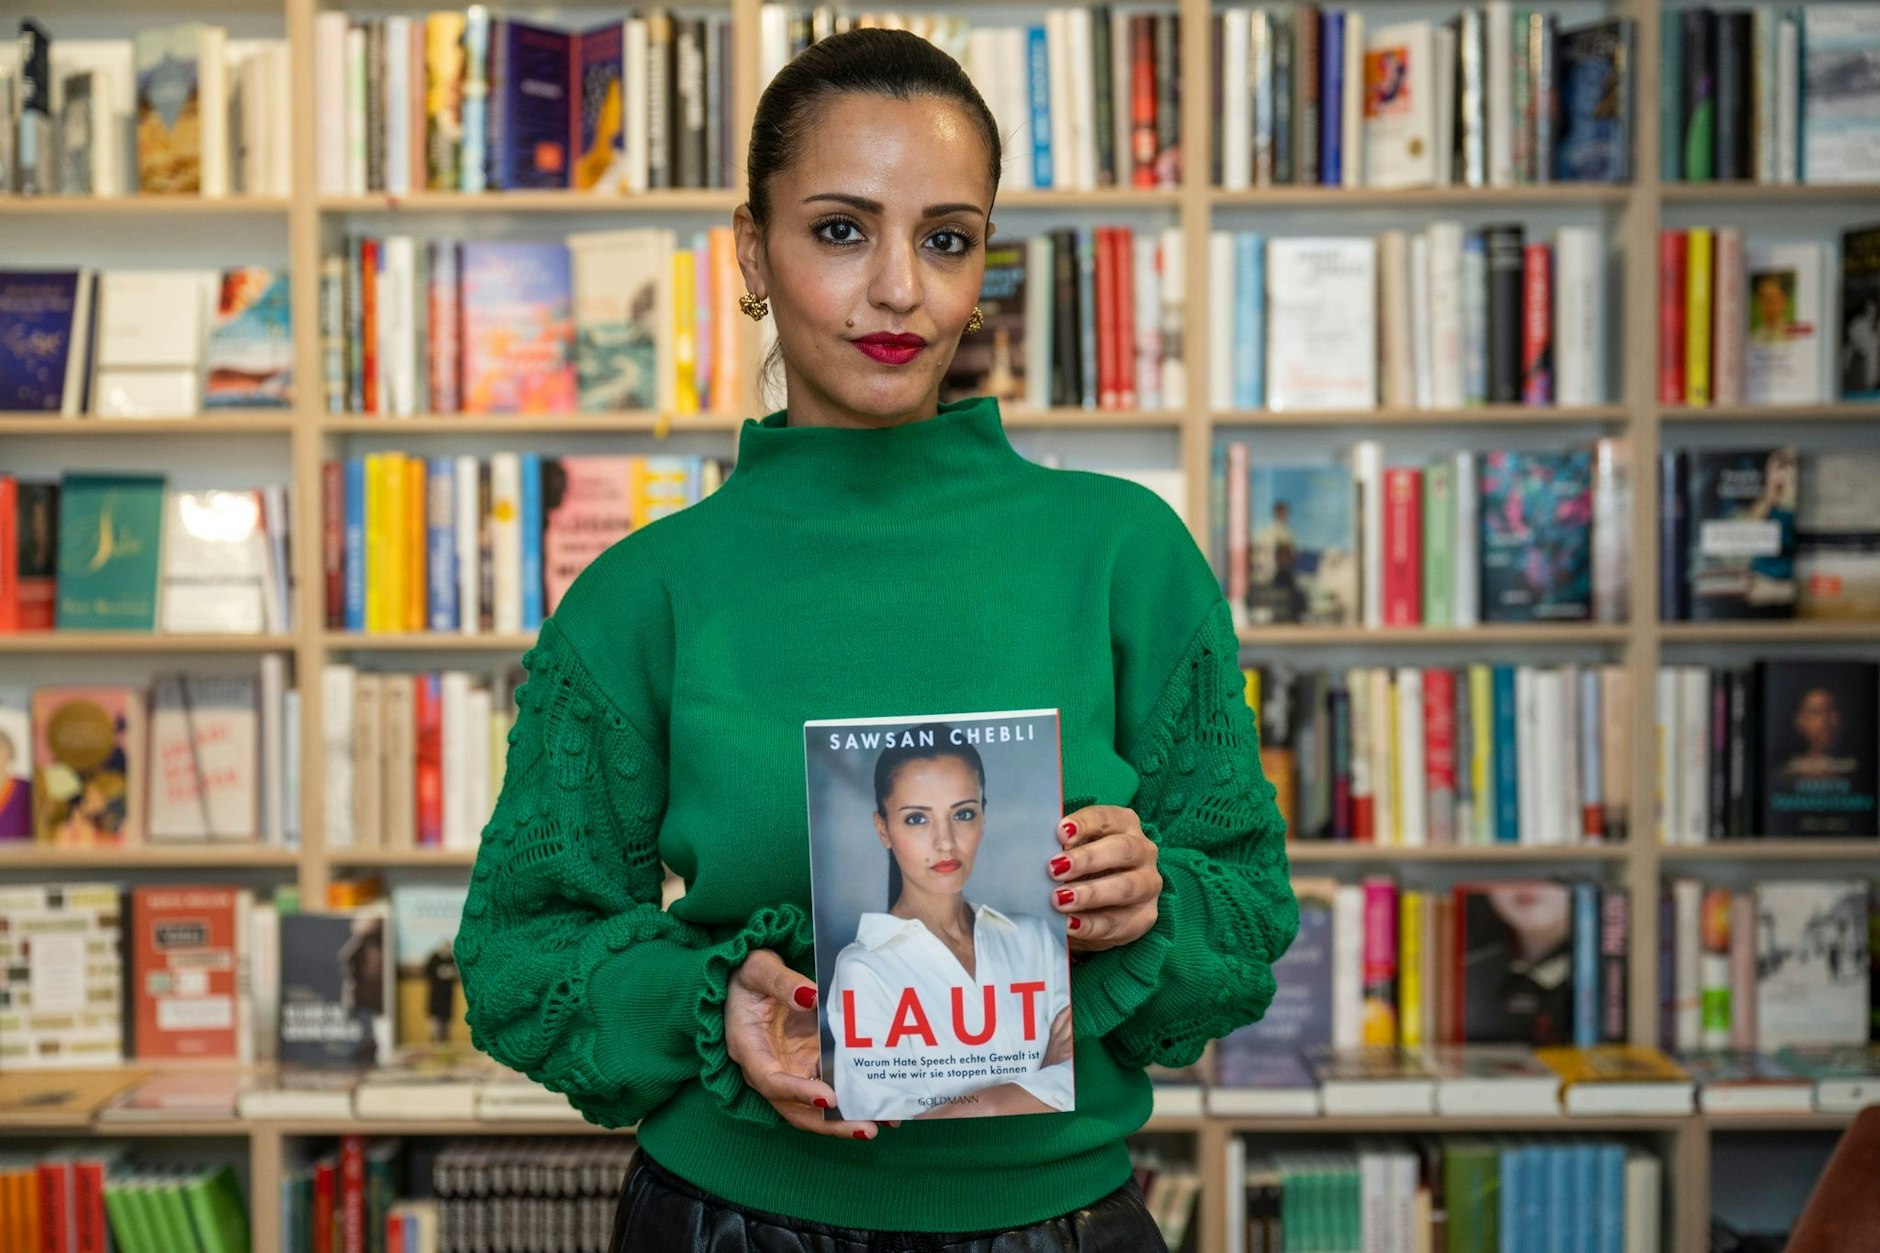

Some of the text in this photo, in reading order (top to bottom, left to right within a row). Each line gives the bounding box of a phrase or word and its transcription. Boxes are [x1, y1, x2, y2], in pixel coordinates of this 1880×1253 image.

[829, 724, 1034, 750] SAWSAN CHEBLI
[842, 981, 1046, 1048] LAUT
[853, 1050, 1040, 1069] Warum Hate Speech echte Gewalt ist
[867, 1065, 1027, 1080] und wie wir sie stoppen können
[917, 1095, 980, 1108] GOLDMANN
